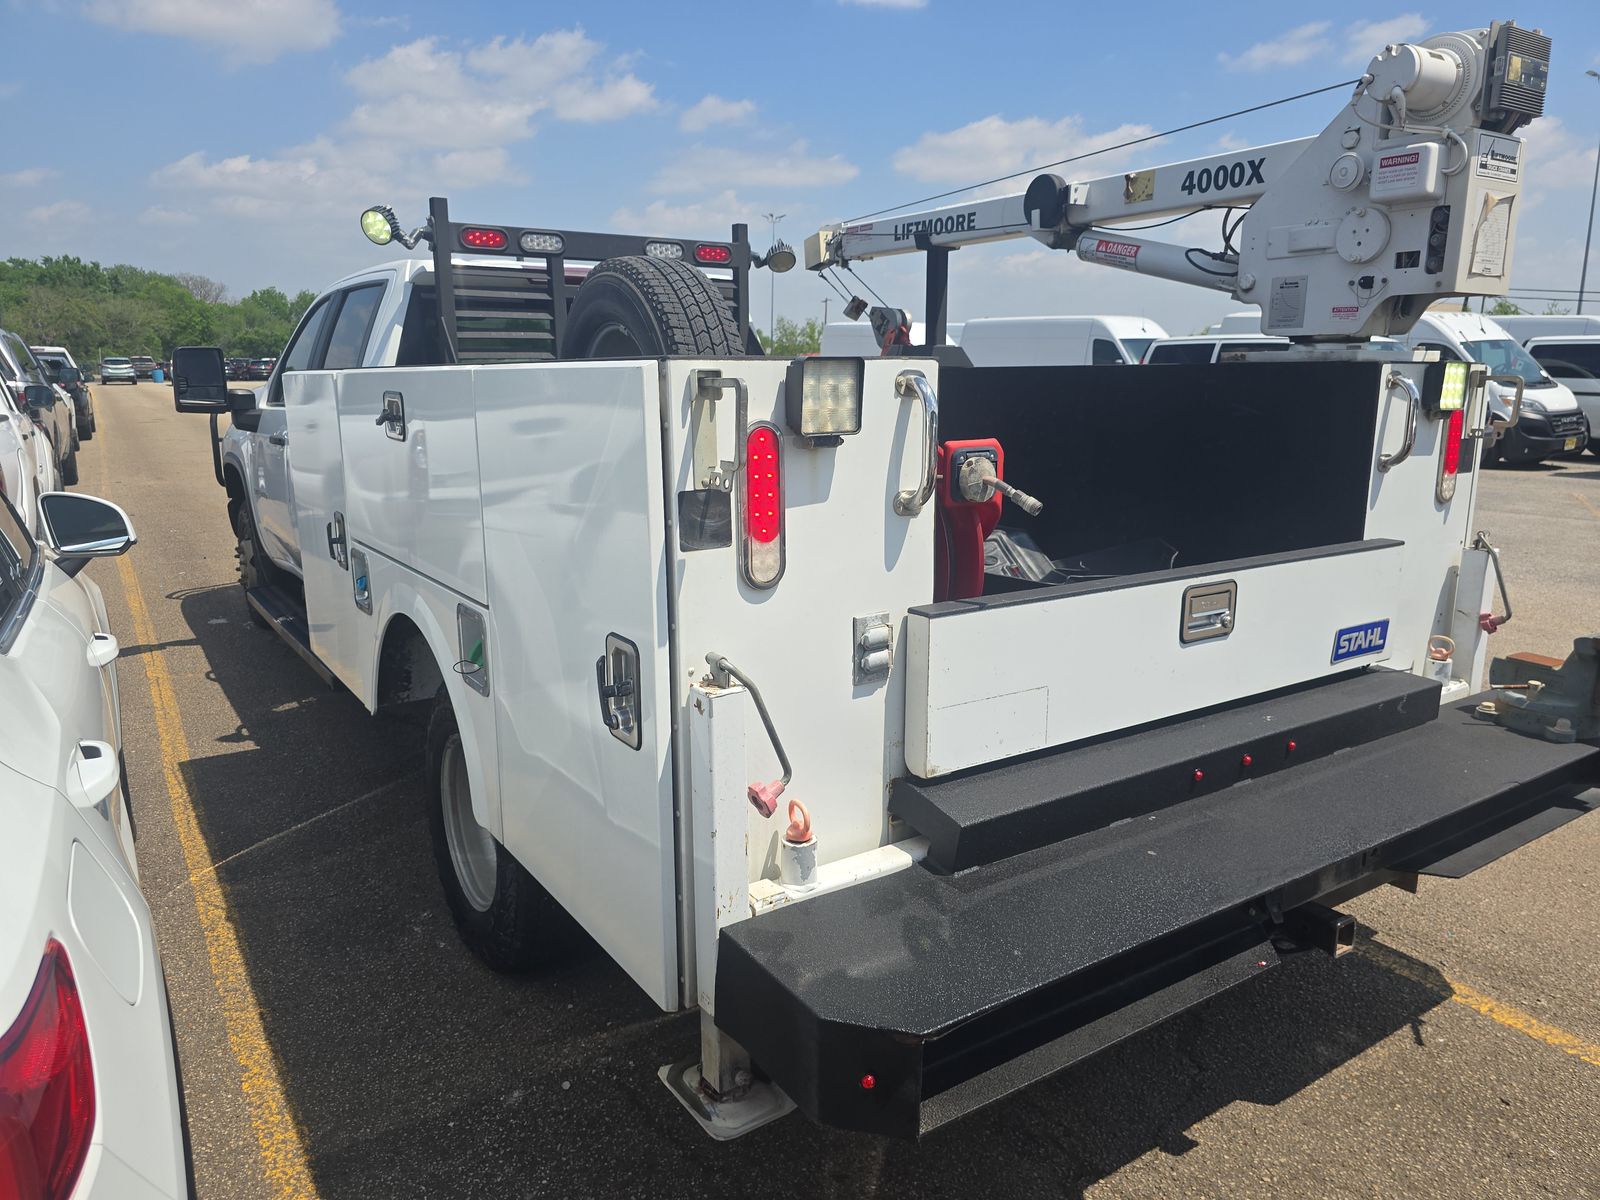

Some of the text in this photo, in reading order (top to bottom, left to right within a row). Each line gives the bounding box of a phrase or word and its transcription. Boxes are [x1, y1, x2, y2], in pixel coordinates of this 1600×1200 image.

[1381, 154, 1418, 167] WARNING!
[1181, 157, 1266, 195] 4000X
[894, 212, 977, 242] LIFTMOORE
[1106, 242, 1137, 257] DANGER
[1337, 626, 1384, 655] STAHL
